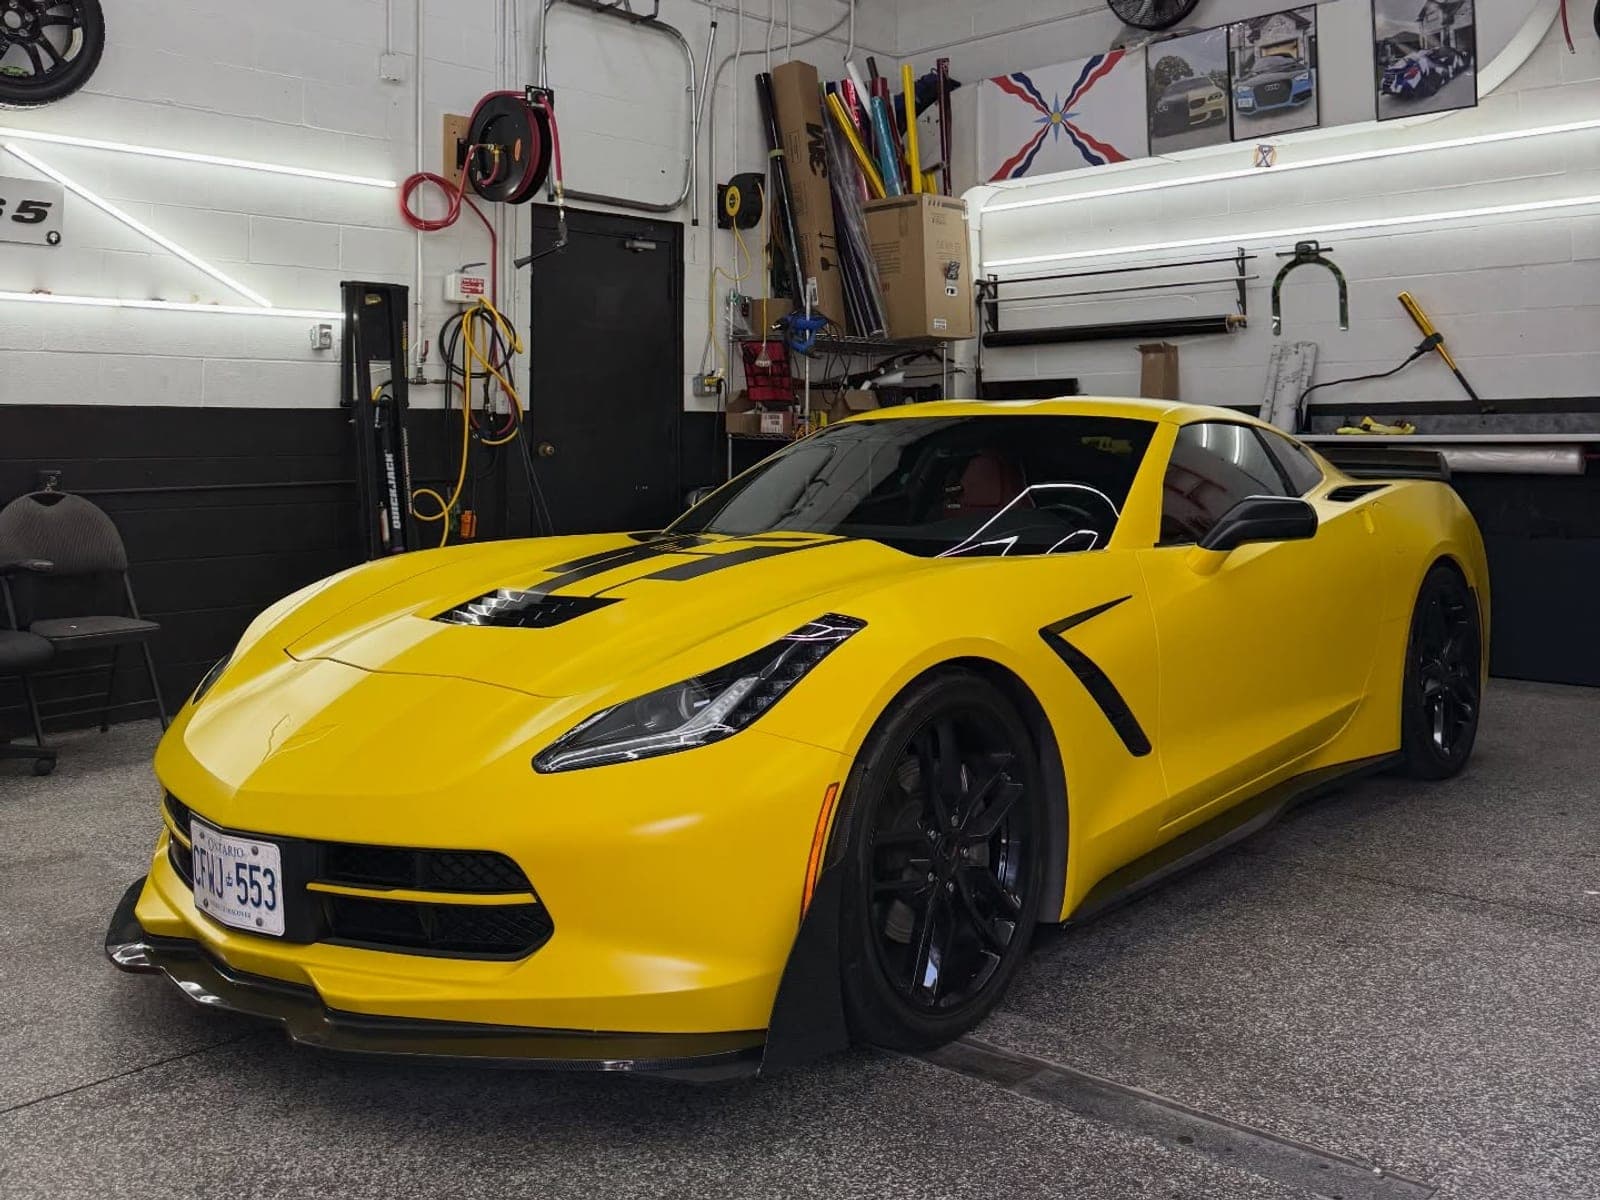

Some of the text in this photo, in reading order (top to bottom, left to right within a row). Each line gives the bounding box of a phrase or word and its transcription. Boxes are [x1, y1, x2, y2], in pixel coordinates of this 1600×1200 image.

[385, 453, 401, 529] QUICKJACK
[193, 845, 275, 910] CFWJ 553
[208, 839, 244, 857] ONTARIO
